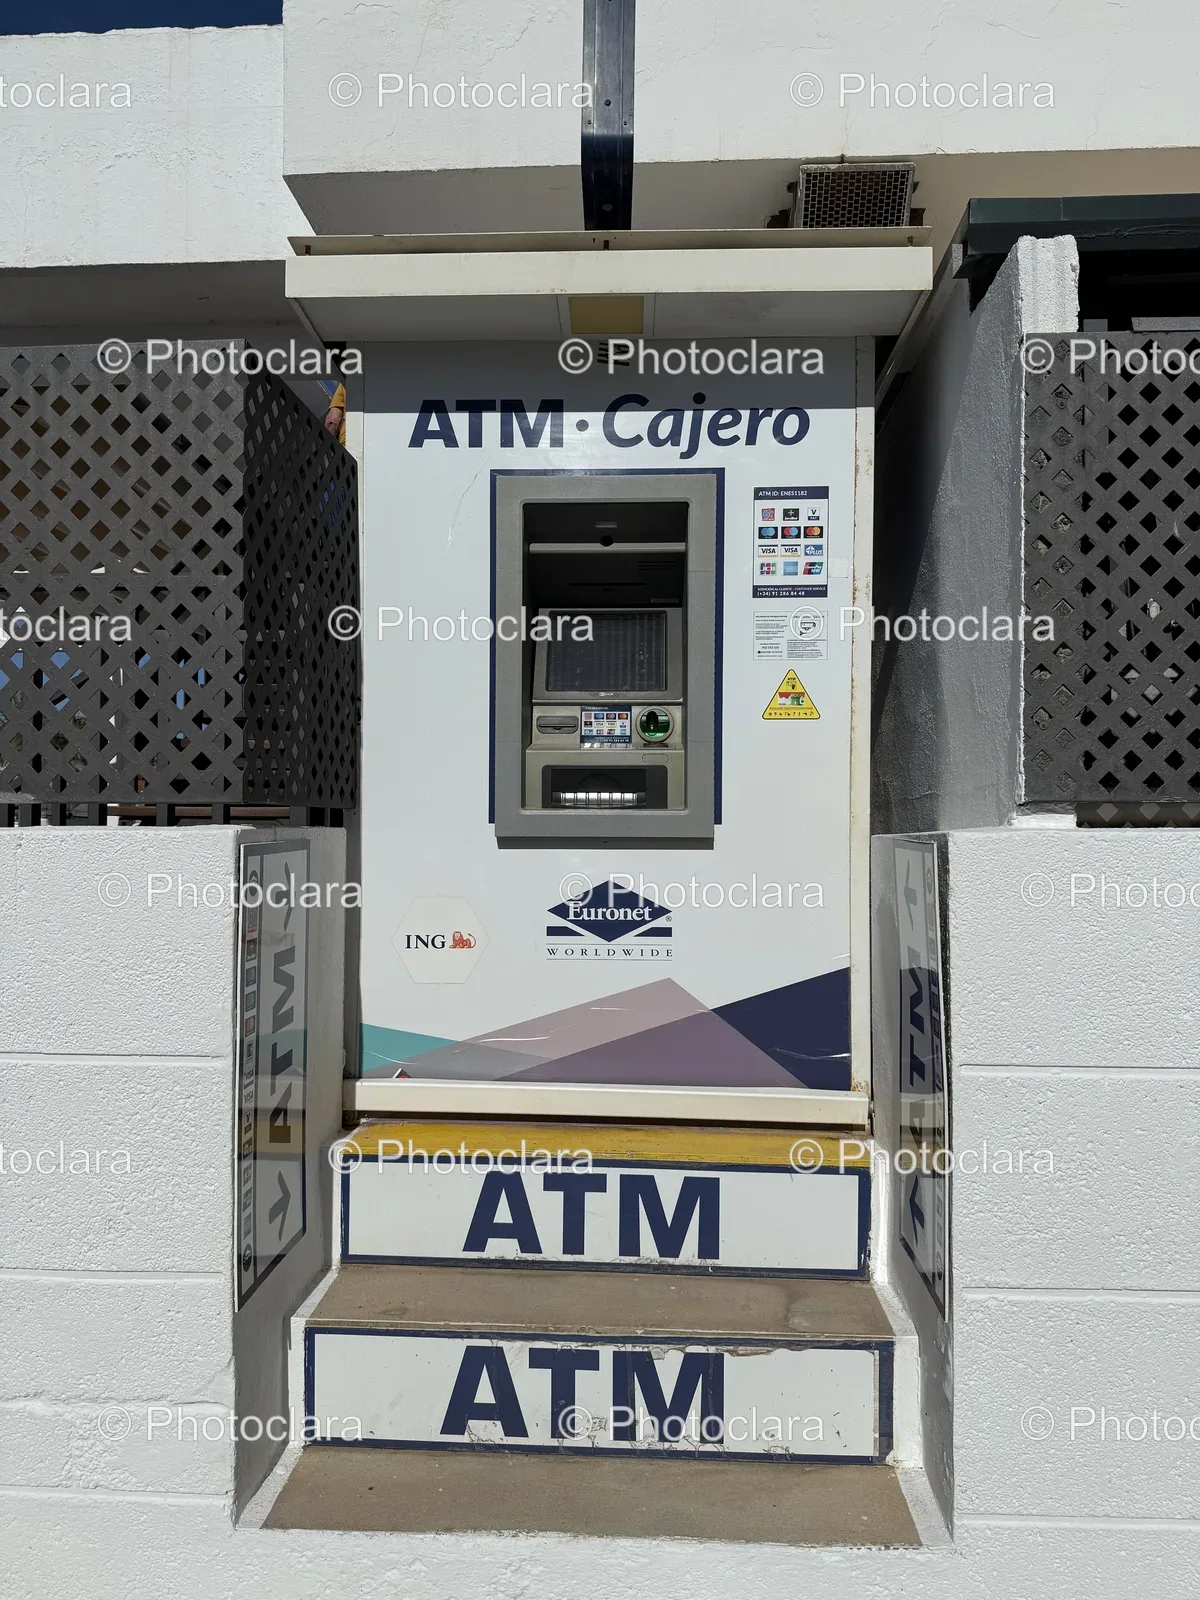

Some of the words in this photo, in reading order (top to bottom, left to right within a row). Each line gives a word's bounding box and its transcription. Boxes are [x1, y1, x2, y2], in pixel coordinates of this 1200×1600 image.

[408, 398, 564, 448] ATM
[602, 391, 811, 460] Cajero
[567, 901, 653, 921] Euronet
[405, 934, 447, 950] ING
[546, 947, 673, 958] WORLDWIDE
[462, 1171, 720, 1260] ATM
[439, 1344, 725, 1444] ATM
